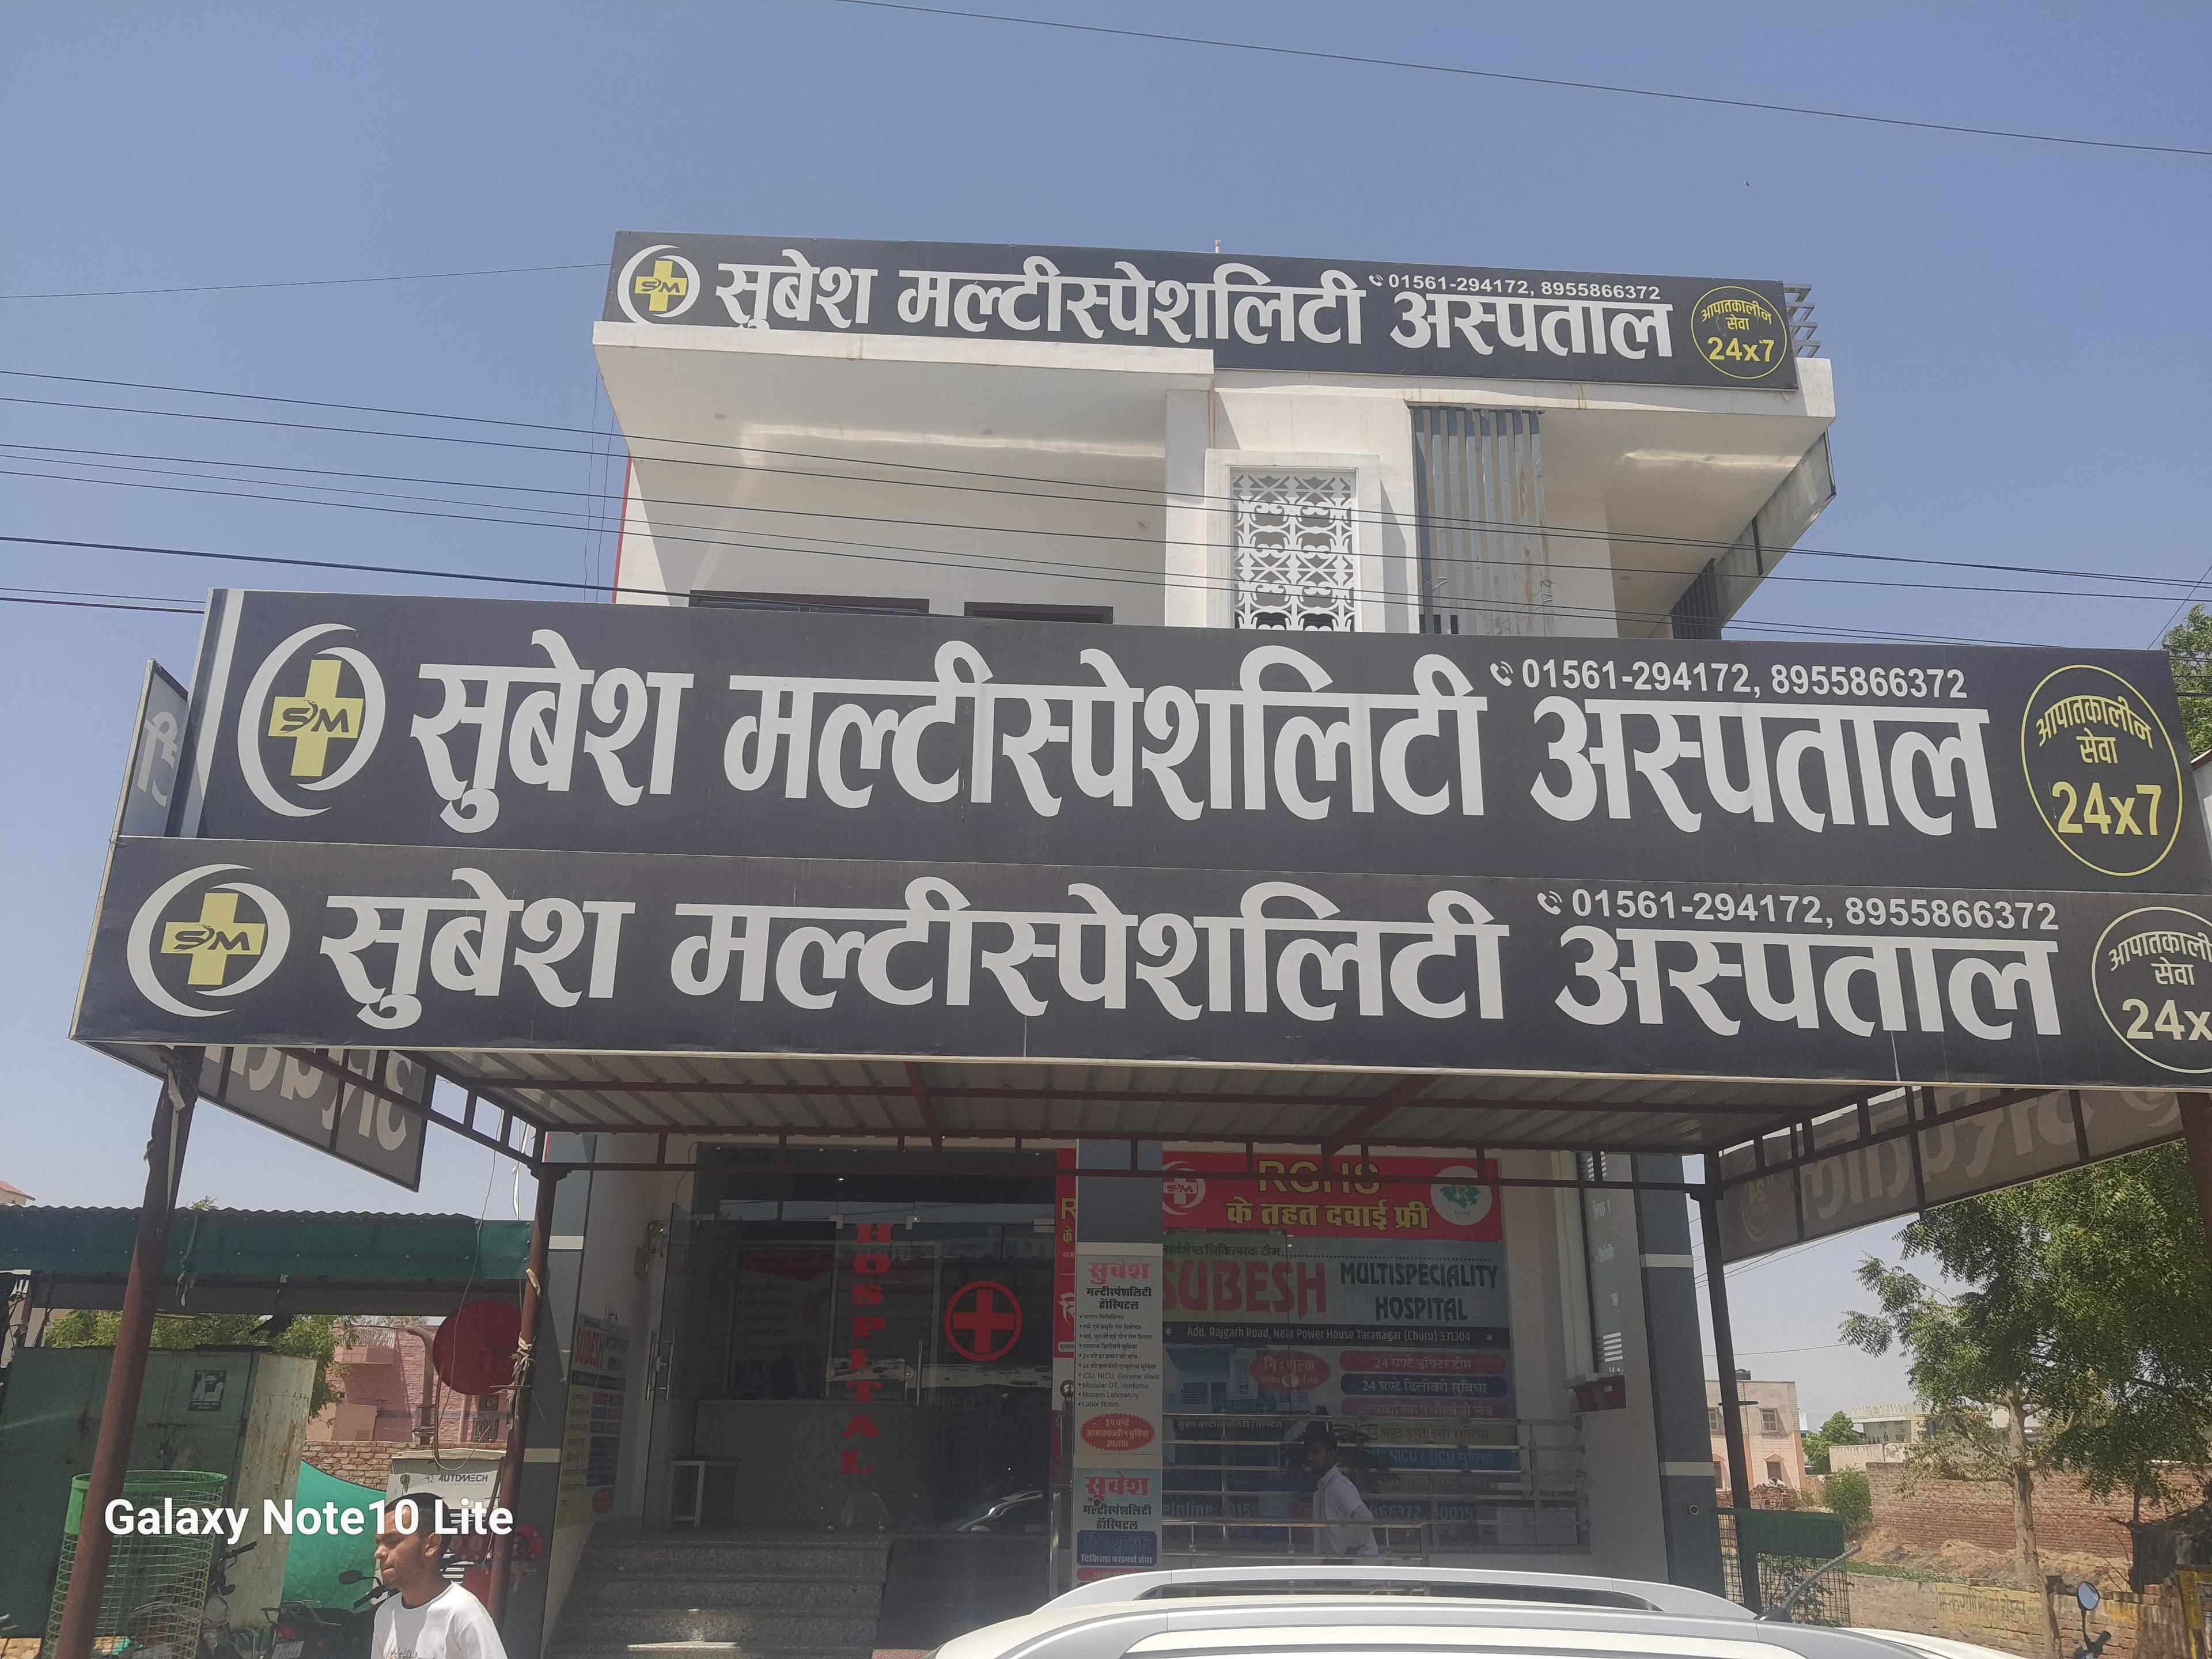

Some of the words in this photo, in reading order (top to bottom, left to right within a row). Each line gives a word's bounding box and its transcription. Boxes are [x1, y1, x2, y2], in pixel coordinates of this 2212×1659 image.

[1388, 274, 1535, 296] 01561-294172,
[1541, 281, 1660, 300] 8955866372
[897, 256, 1366, 344] मल्टीस्पेशलिटी
[1391, 291, 1673, 359] अस्पताल
[1701, 300, 1772, 325] आपातकालीन
[1725, 314, 1749, 330] सेवा
[1707, 336, 1775, 362] 24x7
[1522, 658, 1761, 698] 01561-294172,
[1771, 664, 1968, 699] 8955866372
[410, 629, 694, 833] सुबेश
[724, 641, 1488, 820] मल्टीस्पेशलिटी
[1530, 696, 1998, 836] अस्पताल
[2036, 694, 2153, 749] आपातकालीन
[2076, 728, 2118, 764] सेवा
[2052, 781, 2162, 836] 24x7
[1571, 888, 1834, 930] 01561-294172,
[1845, 896, 2059, 931] 8955866372
[320, 868, 637, 1030] सुबेश
[671, 876, 1509, 1021] मल्टीस्पेशलिटी
[1555, 926, 2062, 1040] अस्पताल
[2108, 931, 2212, 972] आपातकाली
[2150, 956, 2195, 985] सेवा
[2122, 998, 2212, 1041] 24x
[1225, 1196, 1254, 1225] के
[1260, 1202, 1320, 1228] तहत
[1325, 1198, 1389, 1231] दवाई
[1393, 1200, 1430, 1230] फ्री
[1088, 1256, 1151, 1285] सुबेश
[1340, 1262, 1498, 1290] MULTISPECIALITY
[1374, 1296, 1468, 1323] HOSPITAL
[839, 1223, 895, 1474] HOSPITAL
[1209, 1327, 1244, 1339] Rajgarh
[1247, 1327, 1271, 1339] Road,
[1274, 1328, 1293, 1339] Near
[1297, 1329, 1324, 1339] Power
[1326, 1329, 1354, 1339] House
[1356, 1330, 1401, 1342] Taranagar
[1404, 1330, 1438, 1342] (Churu)
[1440, 1331, 1470, 1341] 331304
[1452, 1356, 1472, 1370] टीम
[1451, 1379, 1487, 1397] सुविधा
[438, 1474, 488, 1482] AUTOMECH
